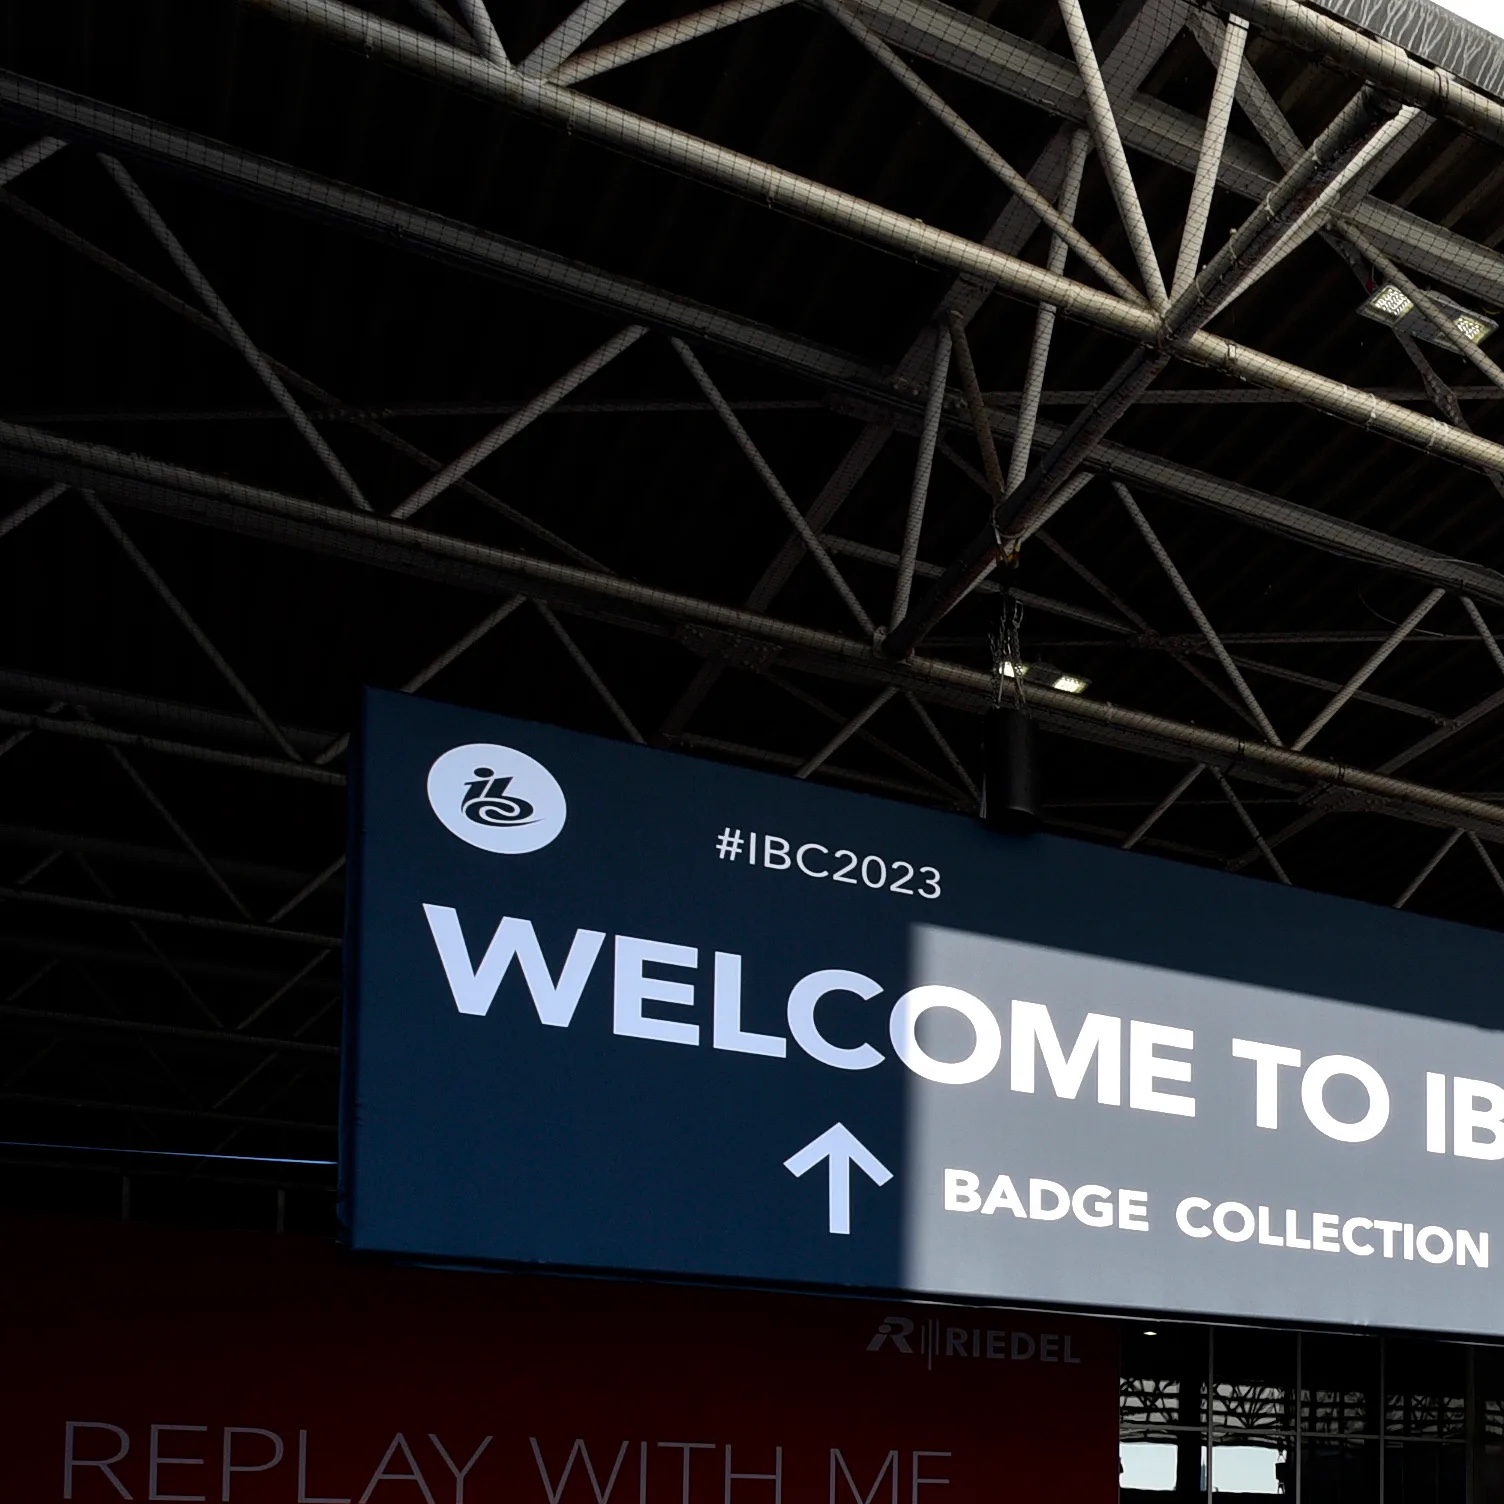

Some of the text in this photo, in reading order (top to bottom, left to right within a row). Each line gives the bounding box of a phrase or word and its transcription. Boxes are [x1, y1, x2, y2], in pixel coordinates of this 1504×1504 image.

[715, 827, 942, 900] #IBC2023
[422, 903, 1197, 1118] WELCOME
[1232, 1037, 1391, 1144] TO
[944, 1168, 1490, 1270] BADGE COLLECTION
[945, 1328, 1081, 1365] RIEDEL
